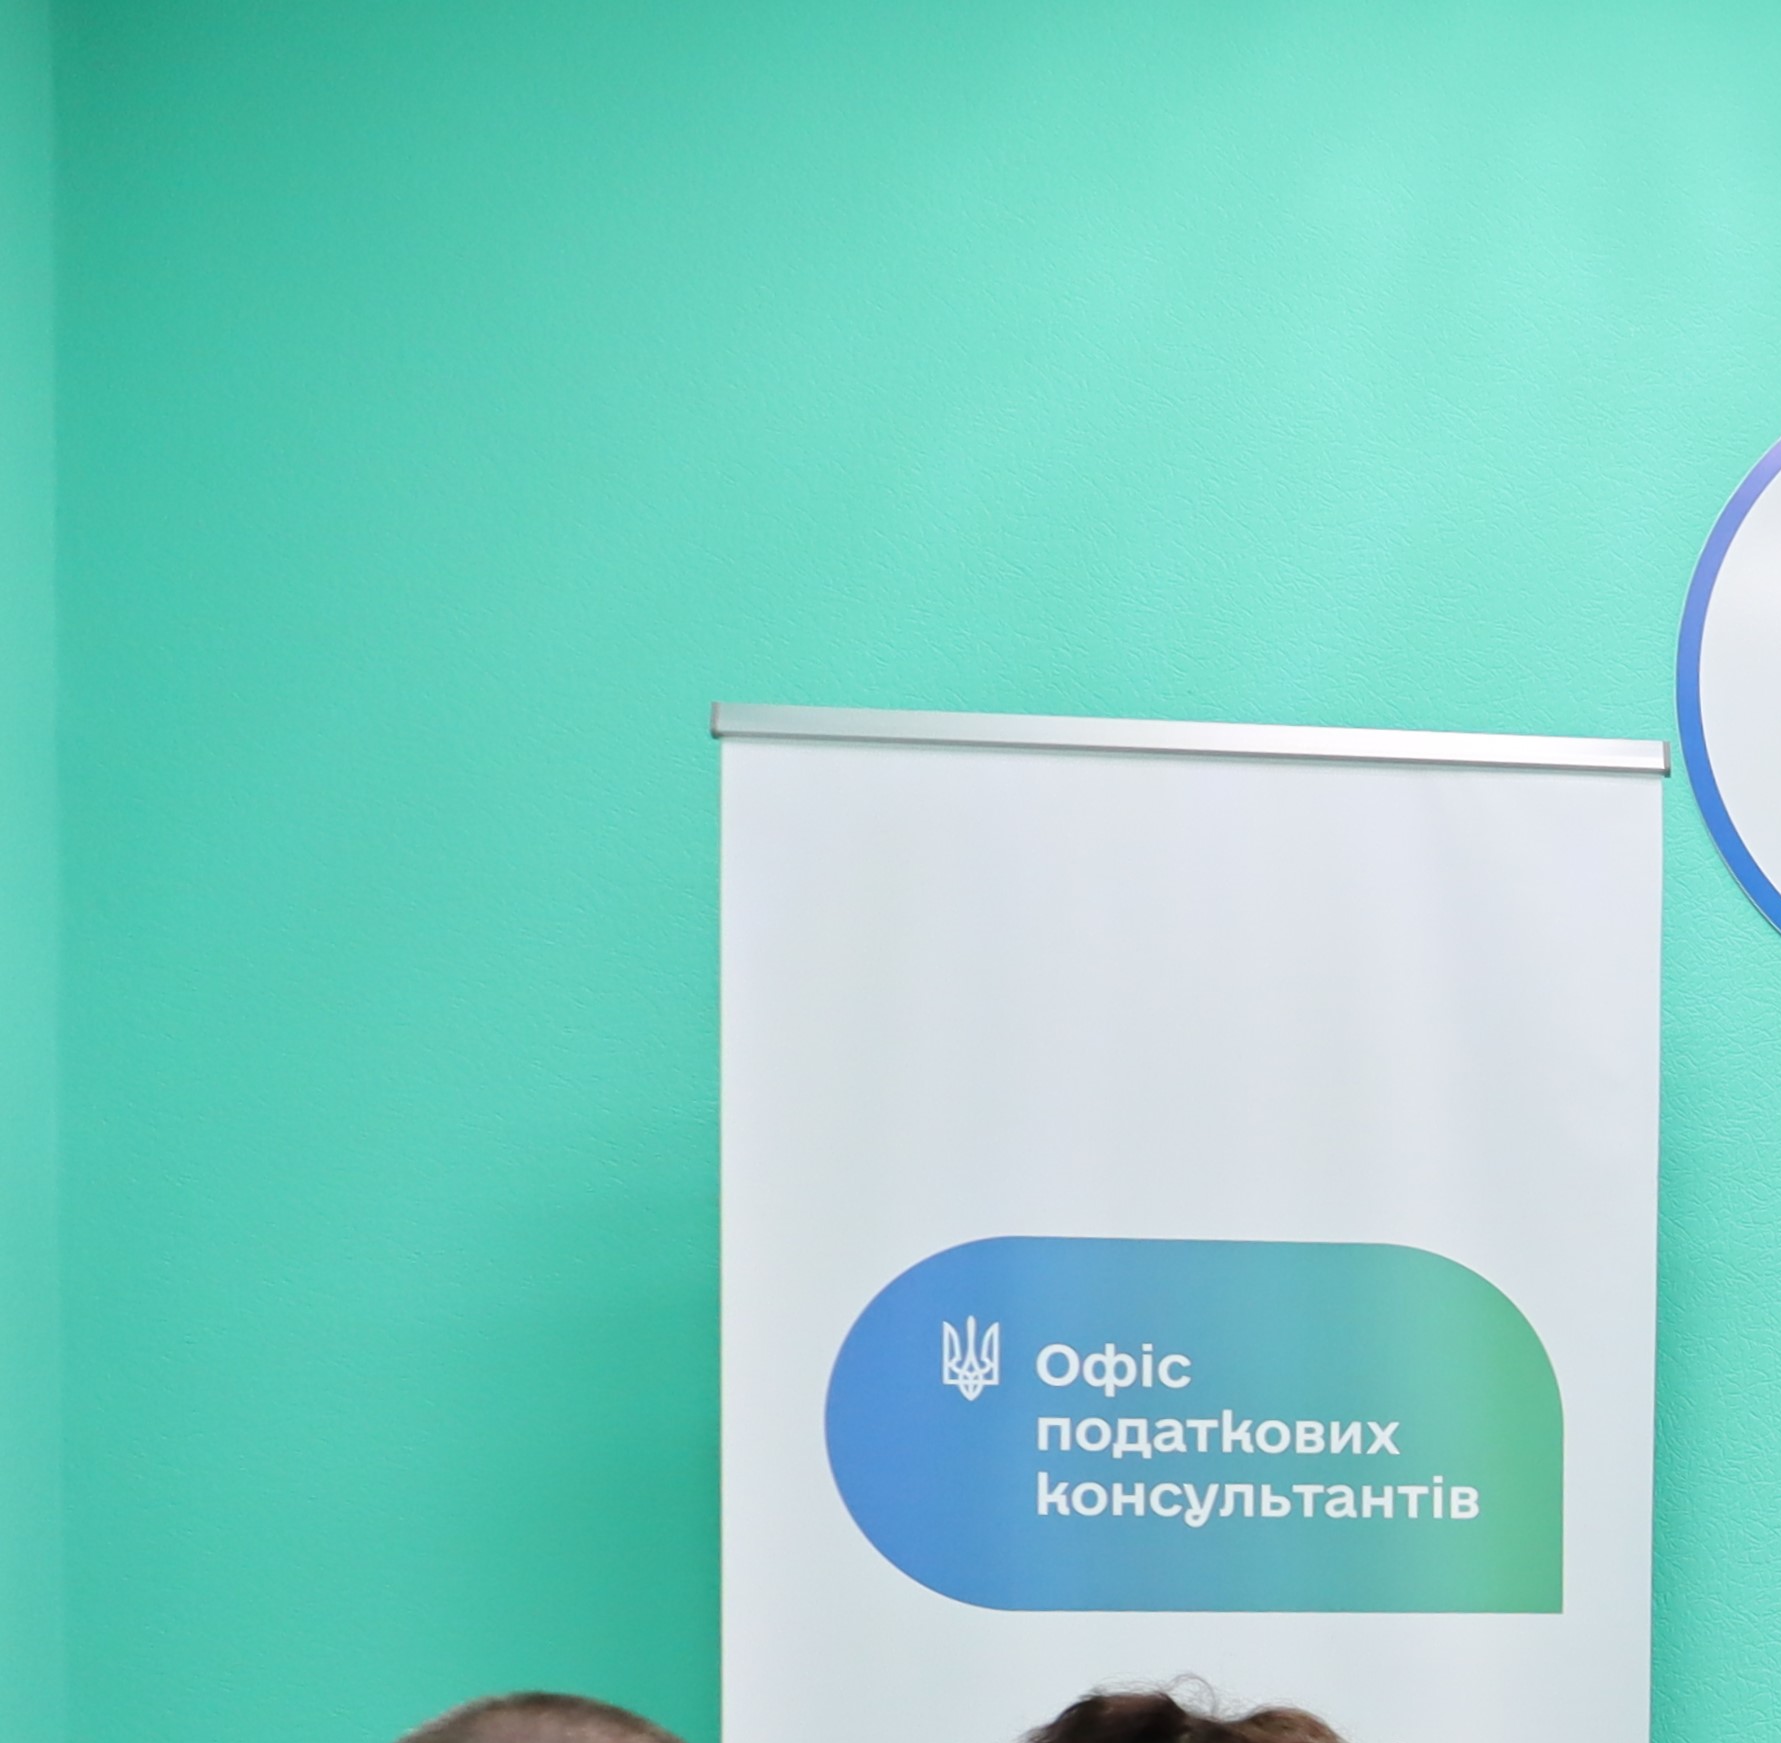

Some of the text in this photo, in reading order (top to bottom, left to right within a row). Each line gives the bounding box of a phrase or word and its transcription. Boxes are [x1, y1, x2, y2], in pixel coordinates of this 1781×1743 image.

[1035, 1342, 1191, 1397] Офіс
[1037, 1409, 1401, 1459] податкових
[1037, 1473, 1480, 1528] консультантів
